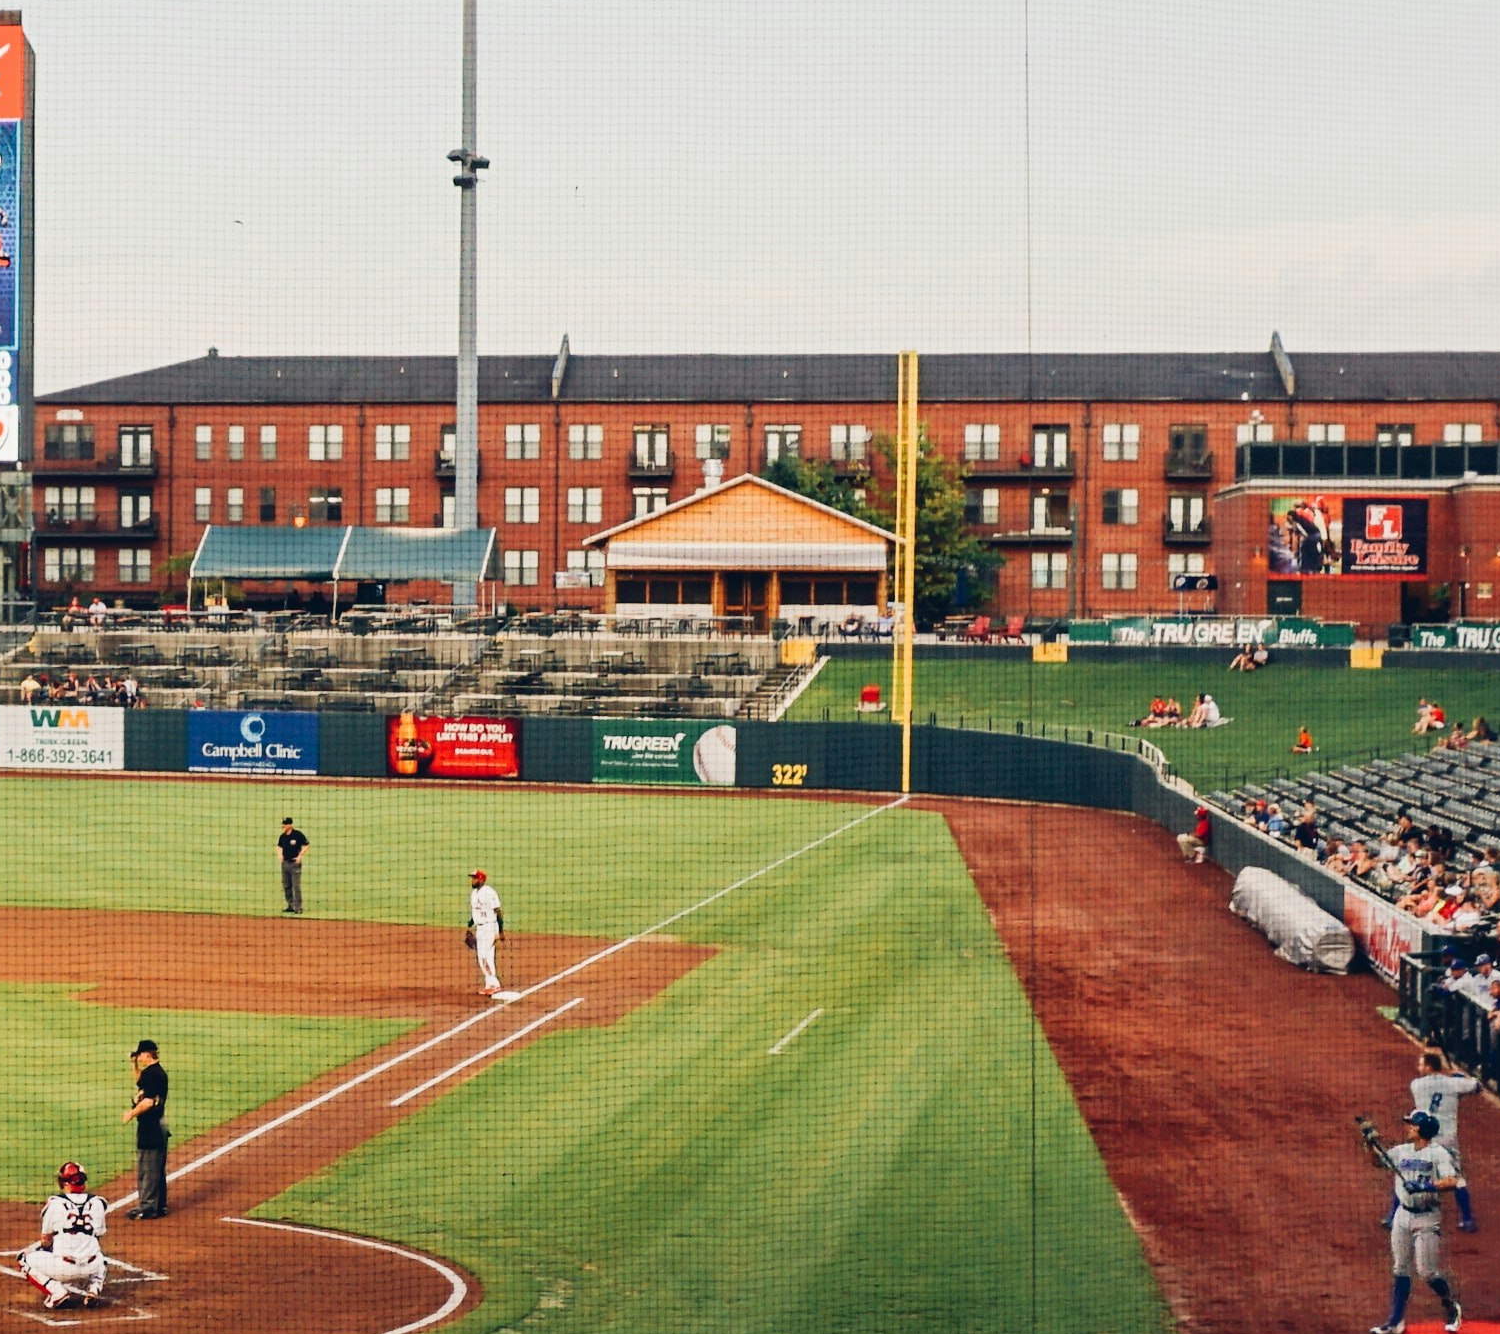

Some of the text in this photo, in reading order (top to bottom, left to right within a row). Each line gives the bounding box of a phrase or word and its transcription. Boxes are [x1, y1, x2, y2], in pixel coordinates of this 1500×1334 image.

[1120, 626, 1146, 643] The
[1278, 628, 1318, 645] Bluffs
[1420, 631, 1446, 648] The
[30, 709, 90, 728] WM
[436, 732, 514, 743] LIKE THIS APPLE?
[443, 723, 506, 734] HOW DO YOU
[603, 733, 682, 751] TRUGREEN
[6, 748, 113, 764] 1-866-392-3641
[202, 742, 302, 761] Campbell Clinic
[771, 763, 808, 785] 322'
